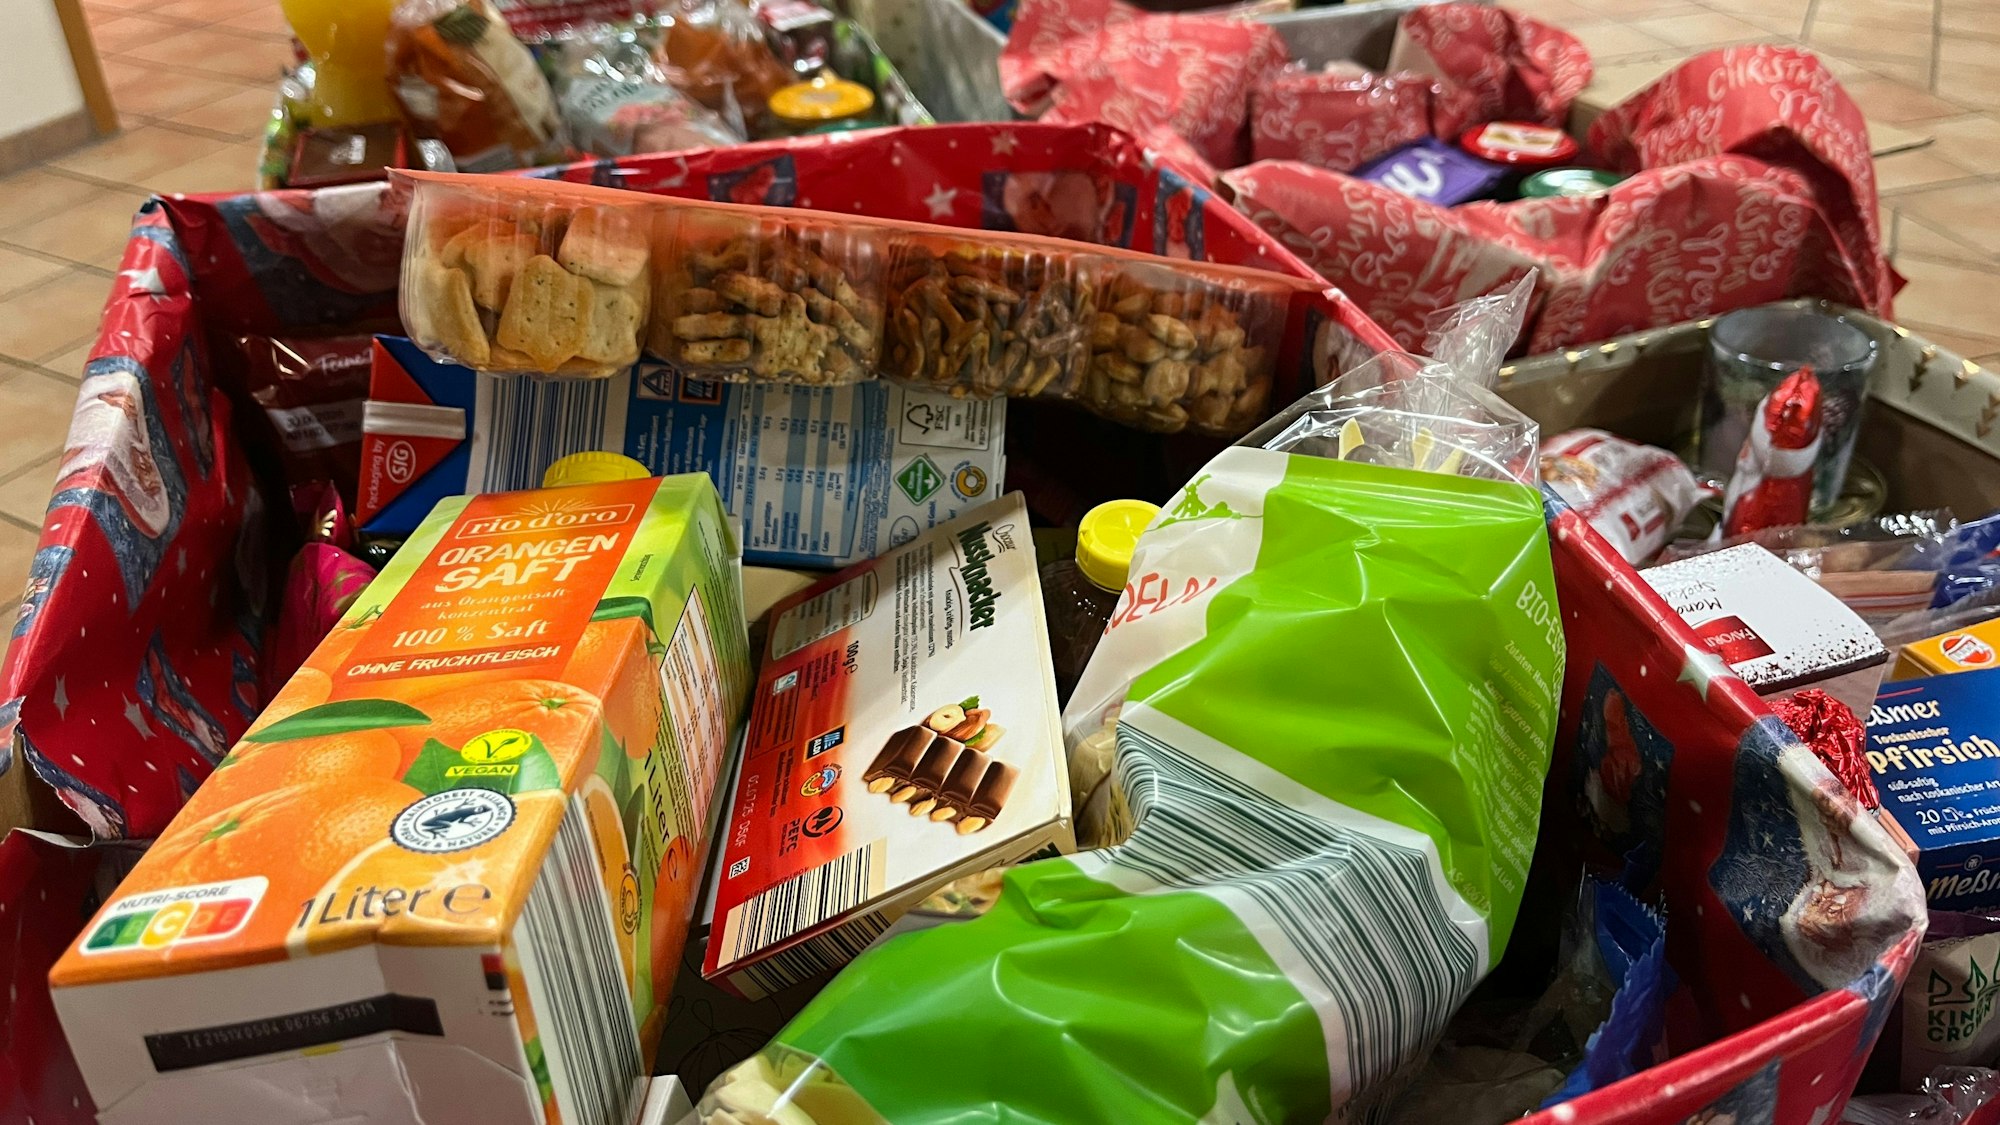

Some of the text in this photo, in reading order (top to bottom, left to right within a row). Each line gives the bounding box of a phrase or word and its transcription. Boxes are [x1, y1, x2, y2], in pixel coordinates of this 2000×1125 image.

[934, 406, 945, 430] FSC
[366, 440, 386, 509] Packaging by
[392, 449, 409, 477] SIG
[470, 510, 618, 536] rio d'oro
[438, 532, 620, 566] ORANGEN
[435, 555, 592, 592] SAFT
[956, 521, 1002, 631] Nussknacker
[420, 600, 450, 609] aus
[438, 603, 535, 621] konzentrat
[1104, 572, 1217, 635] DELN
[392, 619, 552, 649] 100 % Saft
[347, 646, 561, 677] OHNE FRUCHTFLEISCH
[1504, 640, 1533, 676] Zutaten:
[1501, 700, 1531, 734] Spuren
[1866, 699, 1941, 727] ßmer
[811, 738, 822, 756] ALDI
[1872, 727, 1950, 745] Toskanischer
[1866, 734, 2000, 774] Pfirsich
[452, 766, 514, 775] VEGAN
[1898, 790, 1923, 803] nach
[1923, 783, 1985, 801] toskanischer
[1916, 809, 1941, 825] 20
[1928, 824, 1945, 836] mit
[447, 827, 497, 848] NATURE
[787, 819, 801, 853] PEFC
[1500, 870, 1516, 894] Licht
[117, 884, 231, 911] NUTRI-SCORE
[152, 909, 177, 935] C
